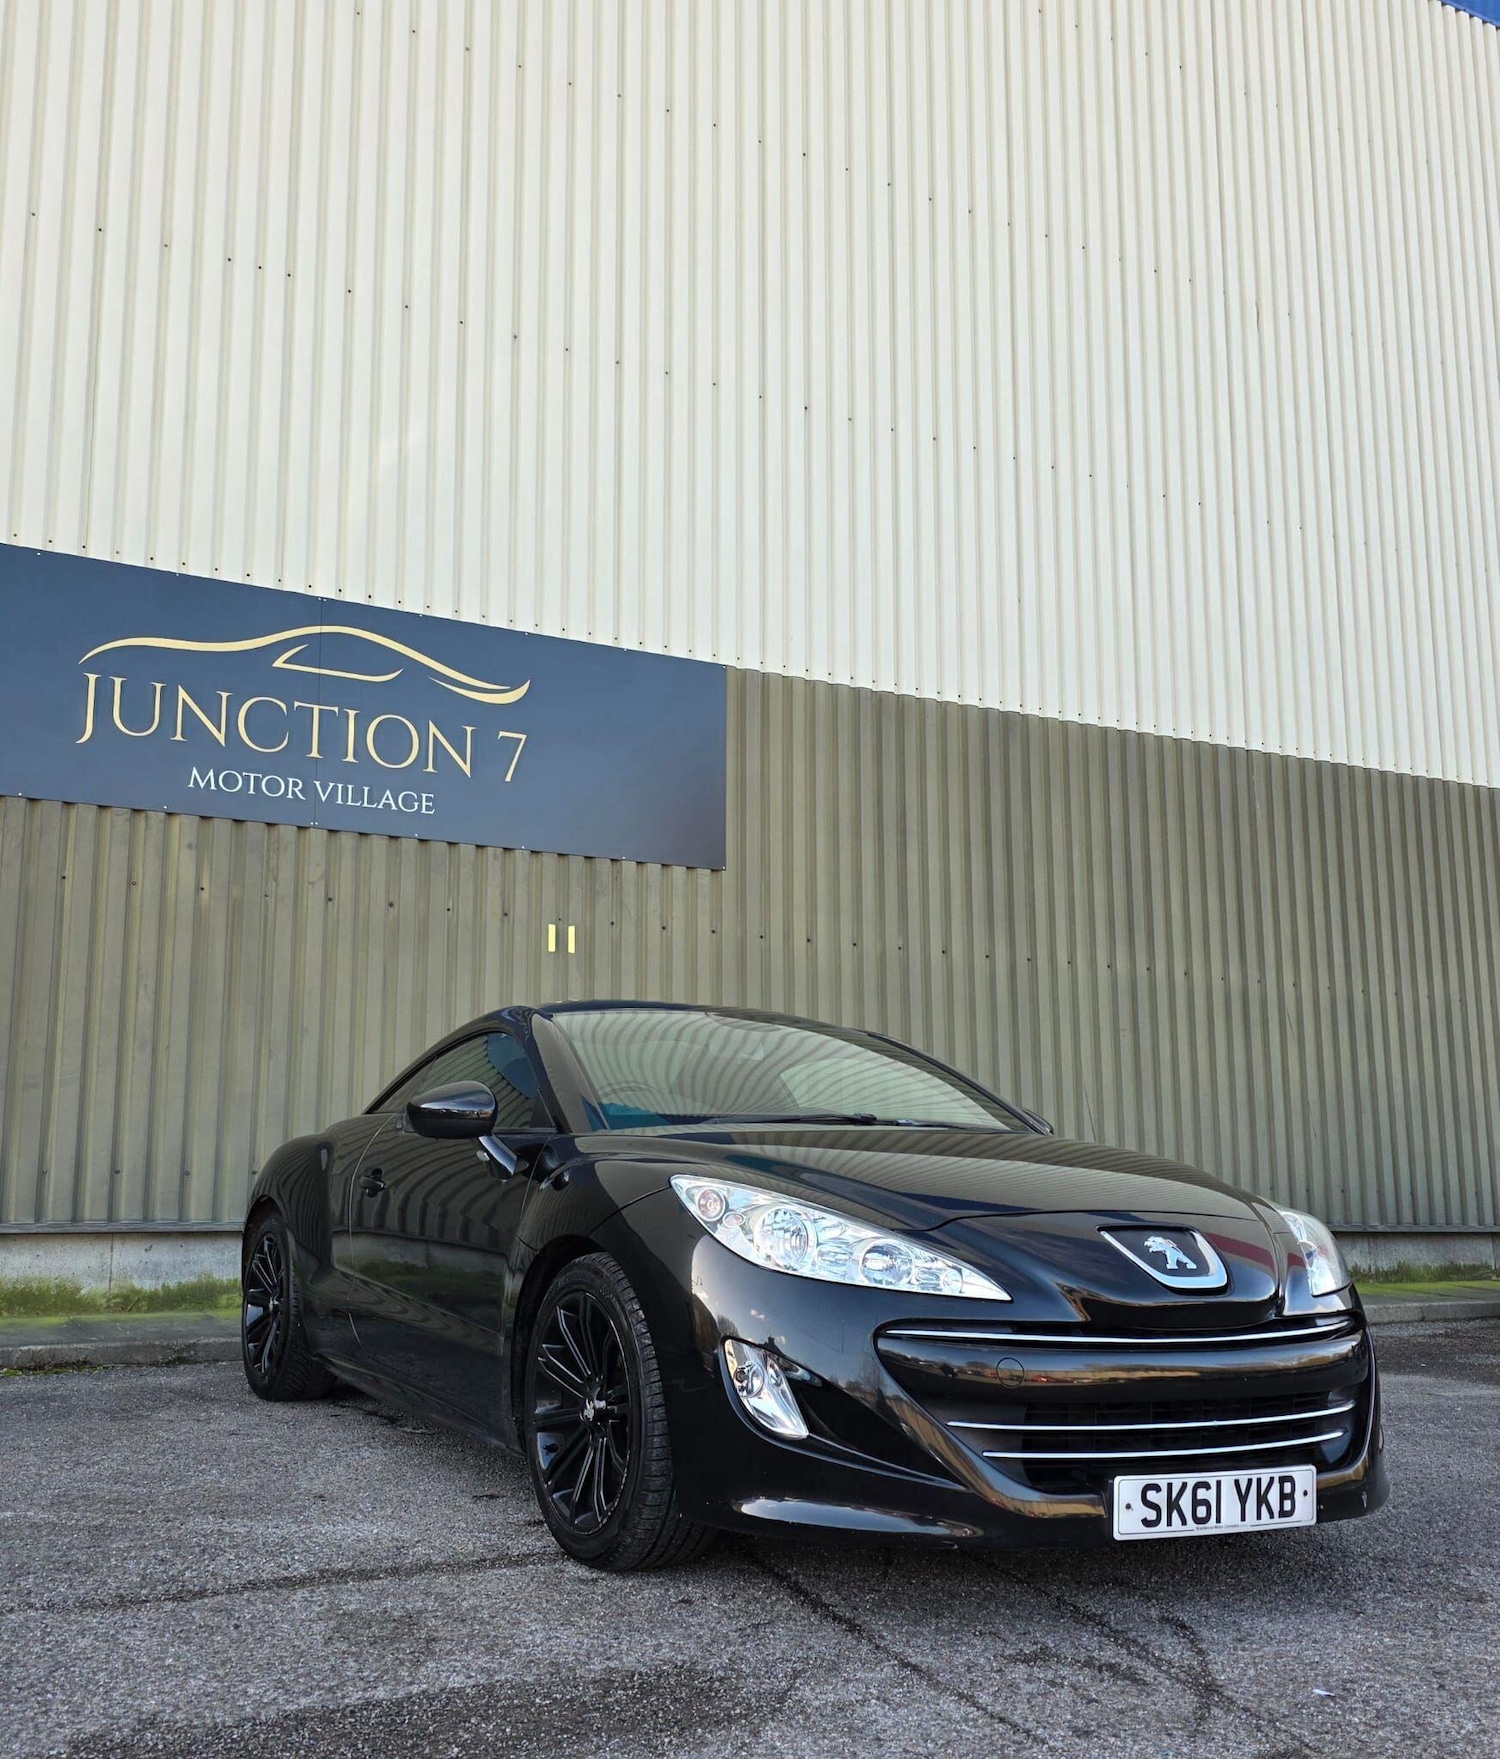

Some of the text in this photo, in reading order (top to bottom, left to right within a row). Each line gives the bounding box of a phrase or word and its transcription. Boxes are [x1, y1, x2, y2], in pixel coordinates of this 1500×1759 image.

[76, 673, 528, 783] JUNCTION 7
[188, 766, 436, 815] MOTOR VILLAGE
[1140, 1475, 1296, 1528] SK61 YKB
